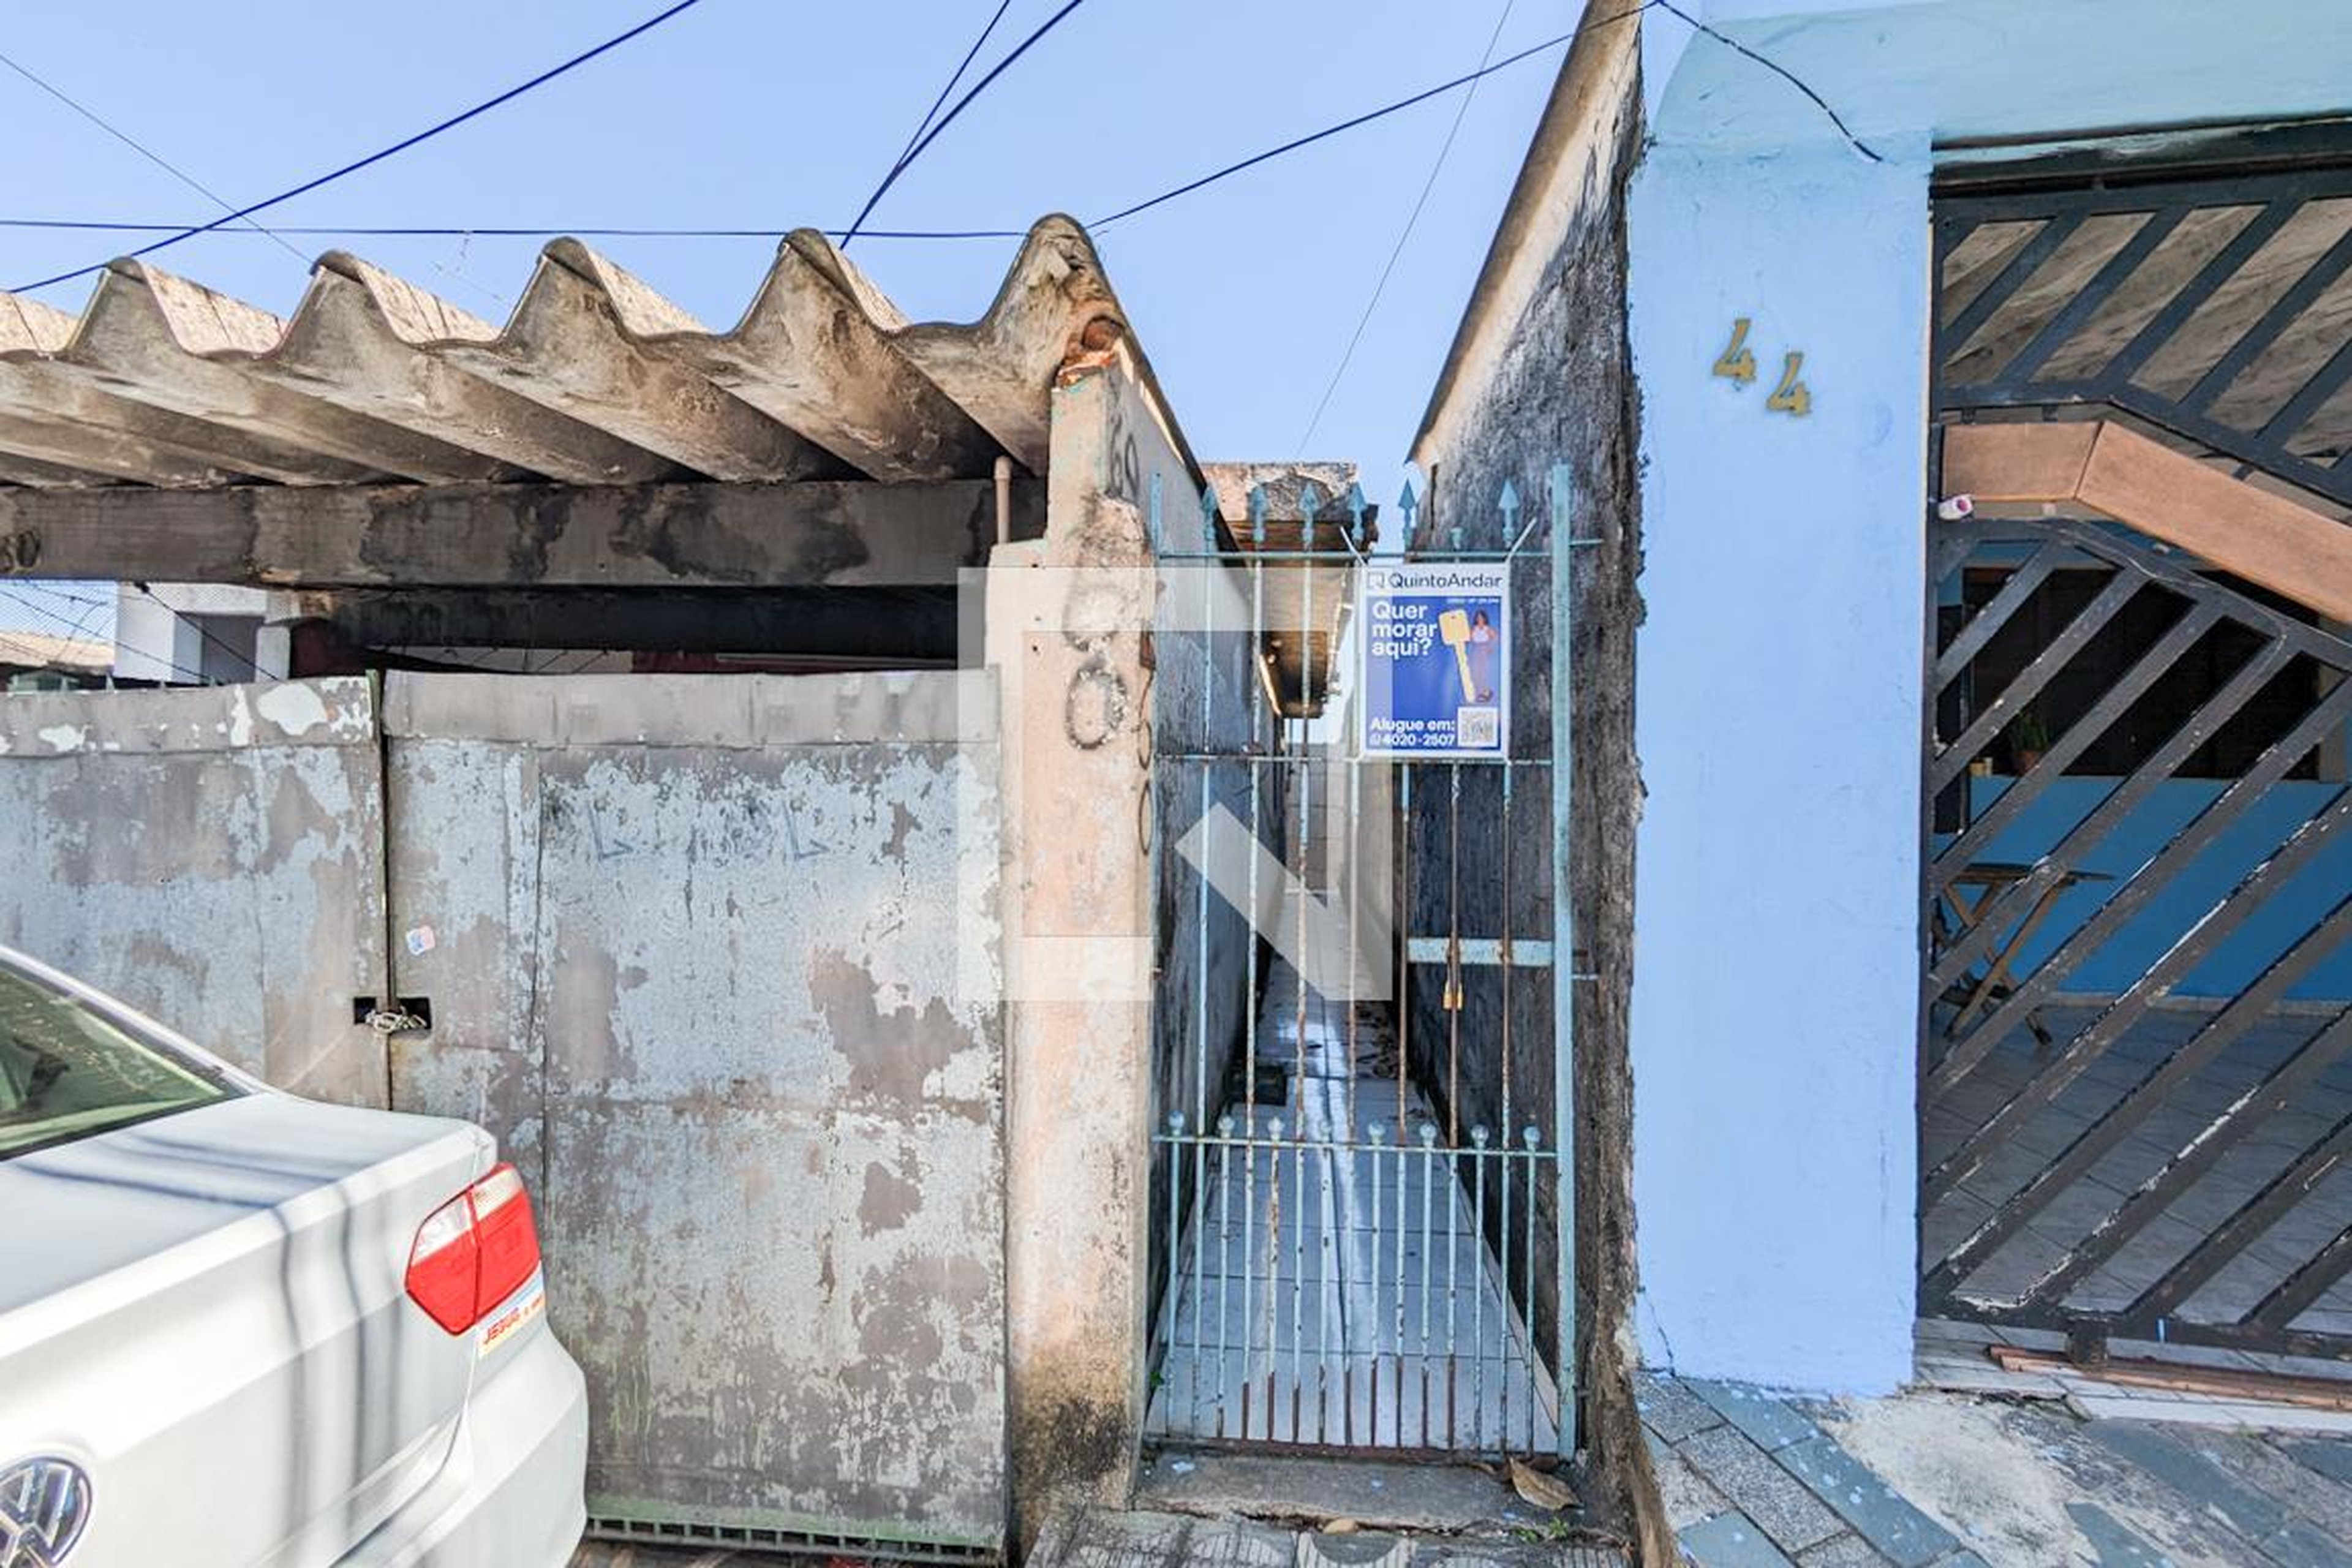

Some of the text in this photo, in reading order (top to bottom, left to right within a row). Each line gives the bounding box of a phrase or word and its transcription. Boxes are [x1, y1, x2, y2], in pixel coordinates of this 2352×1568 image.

[1713, 318, 1811, 417] 44
[1389, 572, 1502, 589] QuintoAndar
[1371, 601, 1428, 620] Quer
[1372, 623, 1438, 638] morar
[1371, 638, 1432, 660] aqui?
[1371, 717, 1455, 733] Alugue em:
